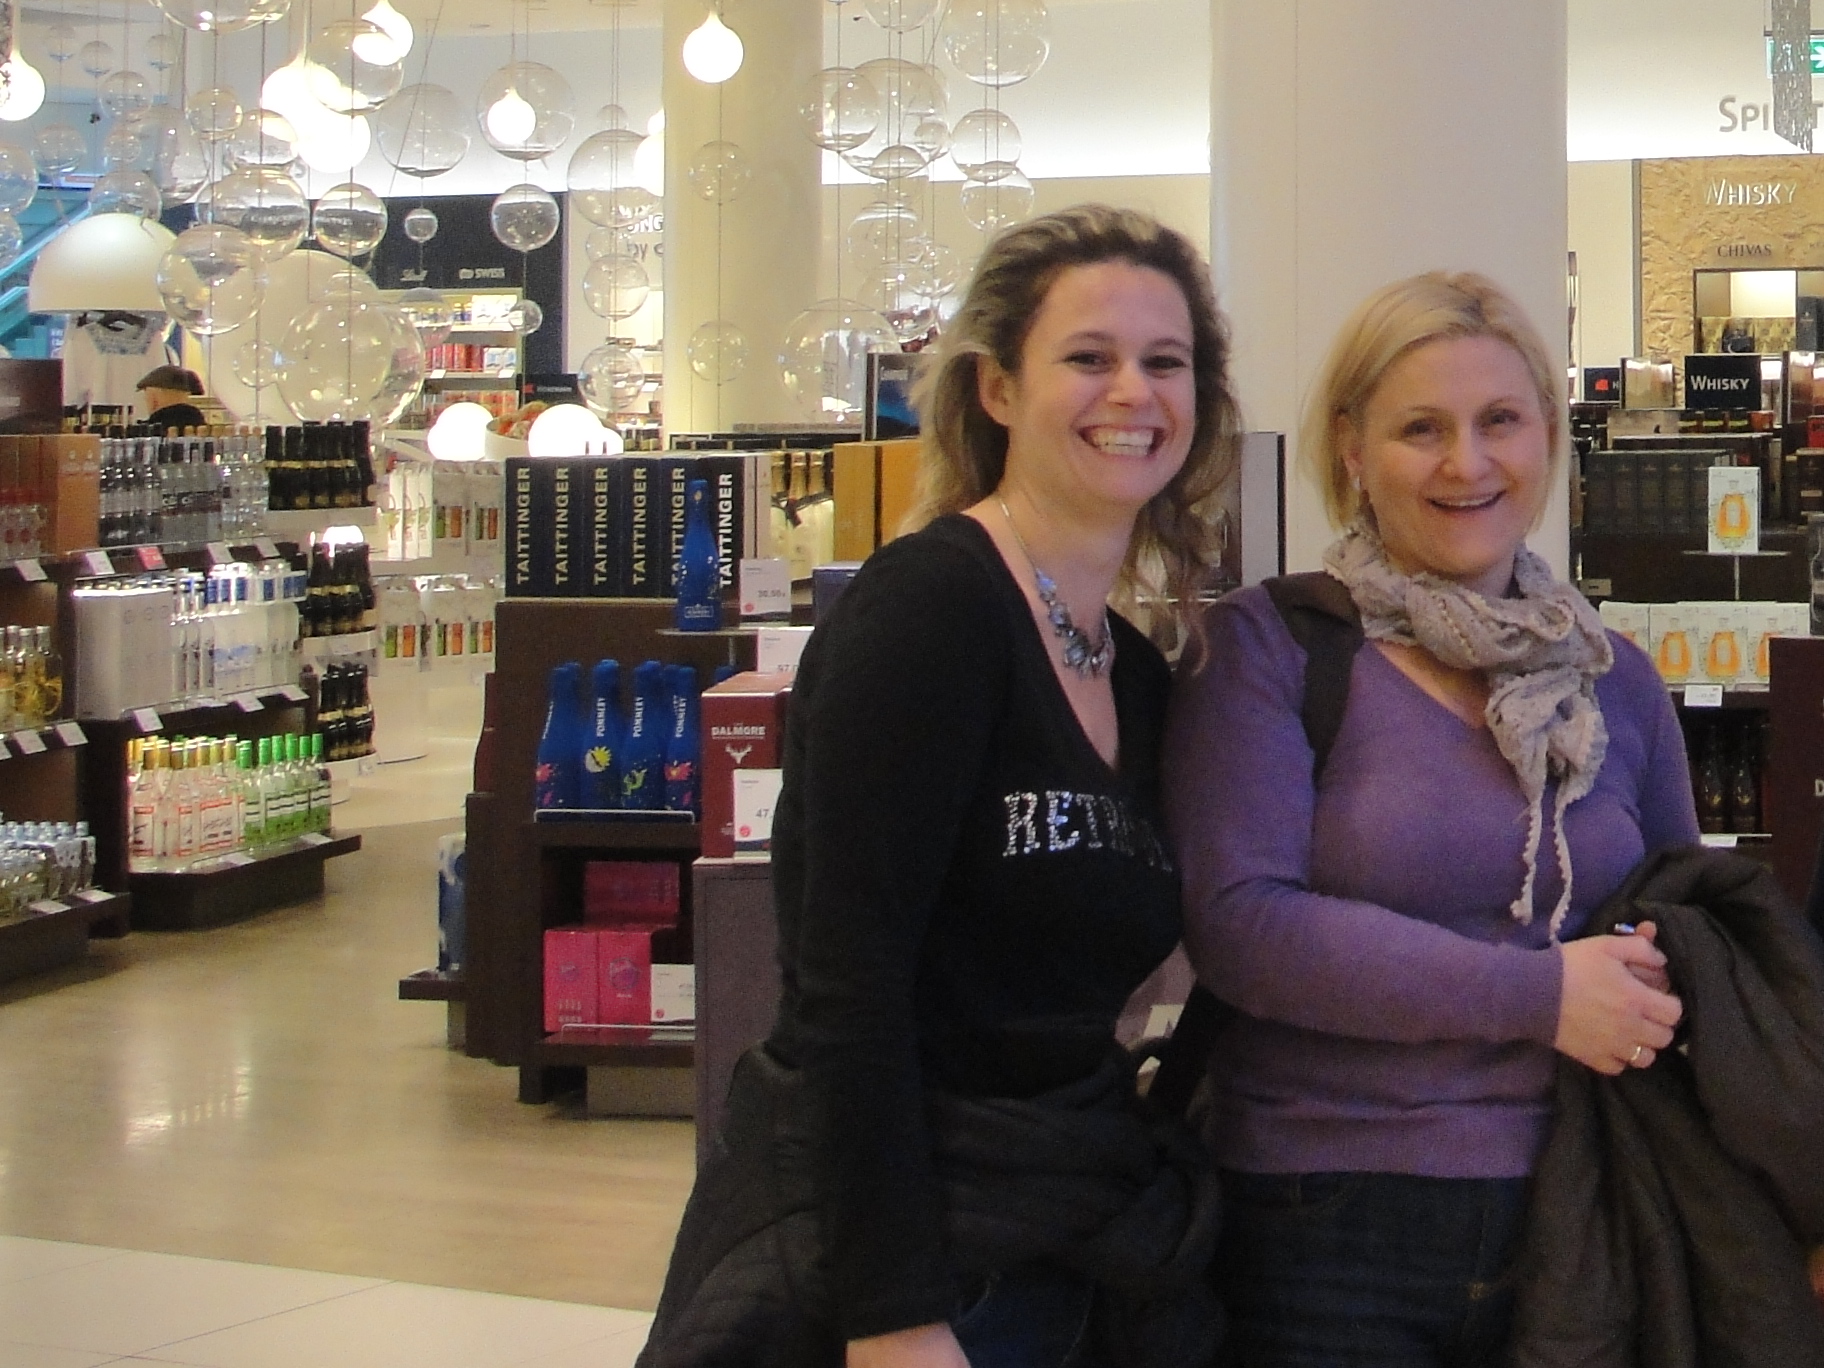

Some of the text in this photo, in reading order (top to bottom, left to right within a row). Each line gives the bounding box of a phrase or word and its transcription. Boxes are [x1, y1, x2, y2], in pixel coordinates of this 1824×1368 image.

[1705, 178, 1797, 206] WHISKY
[1717, 243, 1772, 258] CHIVAS
[516, 467, 531, 585] TAITTINGER
[555, 467, 570, 585] TAITTINGER
[594, 467, 609, 586] TAITTINGER
[633, 467, 647, 586] TAITTINGER
[718, 473, 733, 589] TAITTINGER
[711, 726, 766, 737] DALMORE
